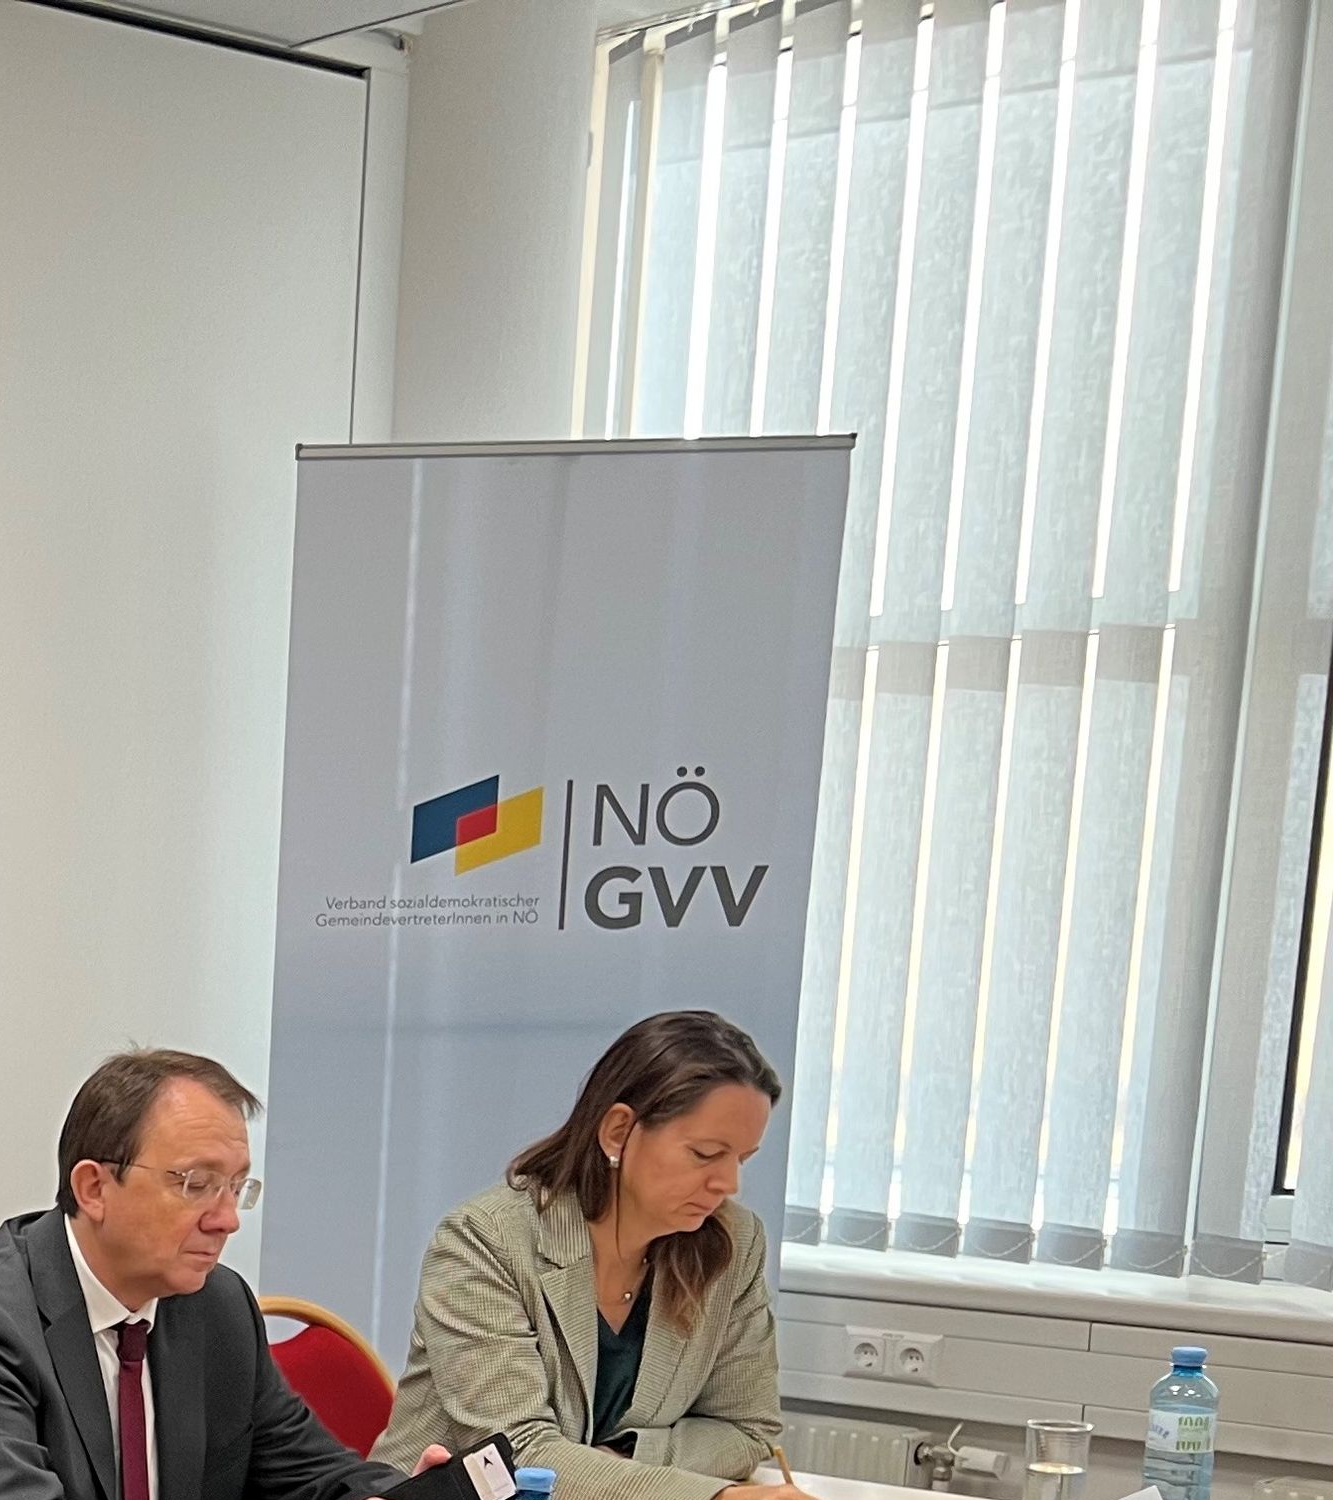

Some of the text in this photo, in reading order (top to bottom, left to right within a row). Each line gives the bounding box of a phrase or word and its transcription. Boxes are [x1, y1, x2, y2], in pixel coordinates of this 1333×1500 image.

[592, 766, 720, 847] NÖ
[315, 908, 539, 928] GemeindevertreterInnen in NÖ
[326, 893, 540, 910] Verband sozialdemokratischer
[584, 865, 769, 931] GVV
